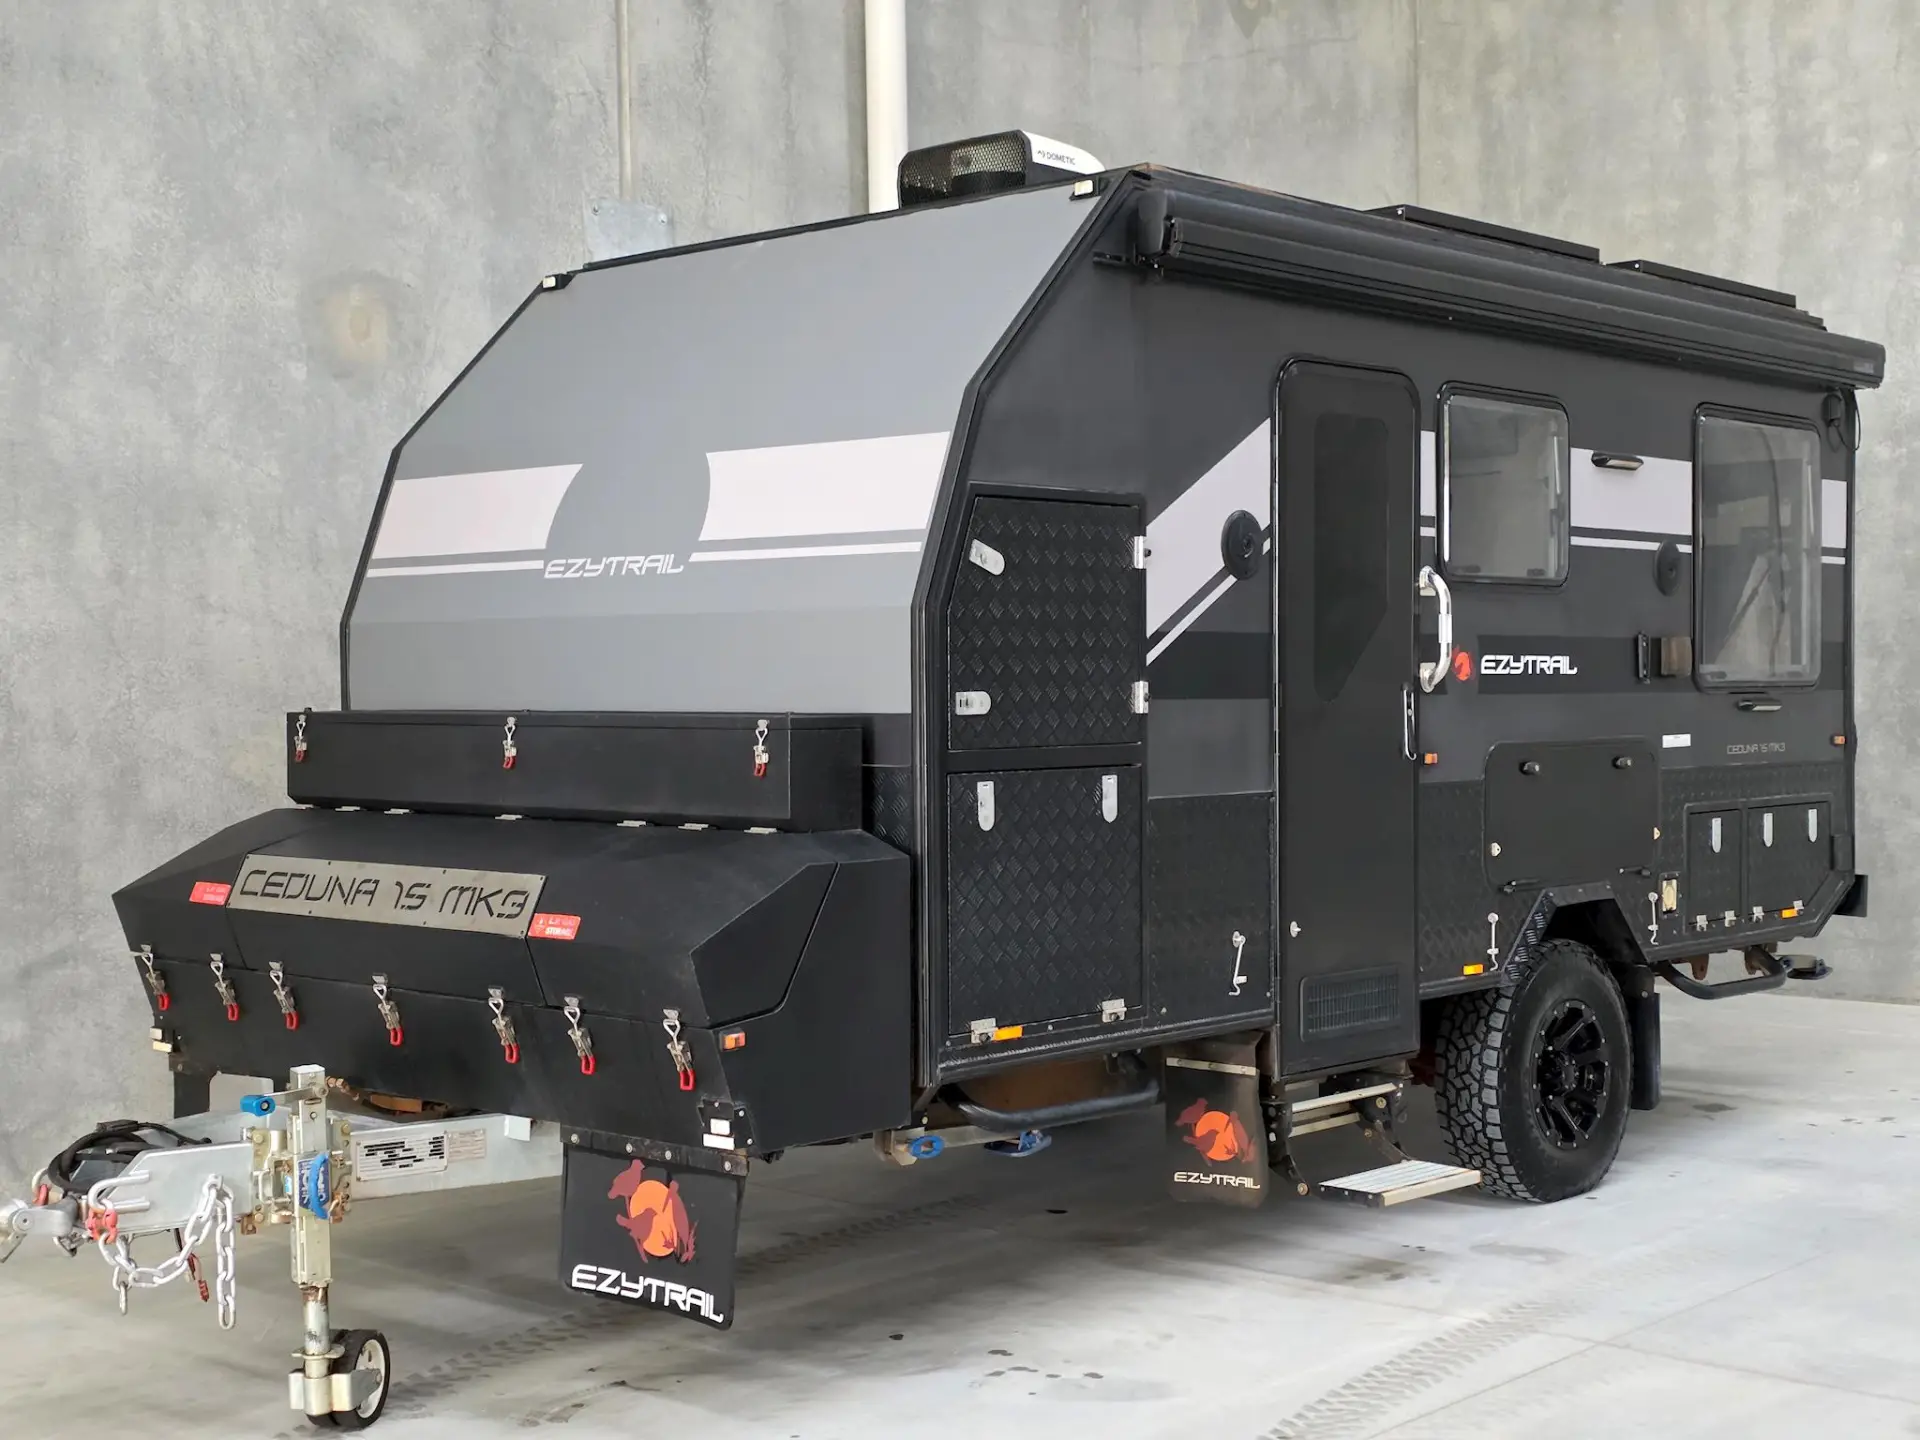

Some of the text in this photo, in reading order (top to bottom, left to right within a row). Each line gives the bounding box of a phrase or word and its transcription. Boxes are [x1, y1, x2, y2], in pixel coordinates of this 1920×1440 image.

[1046, 151, 1076, 166] DOMETIC
[544, 554, 684, 578] EZYTRAIL
[1480, 655, 1578, 675] EZYTRAIL
[240, 869, 380, 907] CEDUNA
[439, 886, 530, 919] MK3
[1174, 1171, 1260, 1189] EZYTRAIL
[571, 1263, 724, 1323] EZYTRAIL
